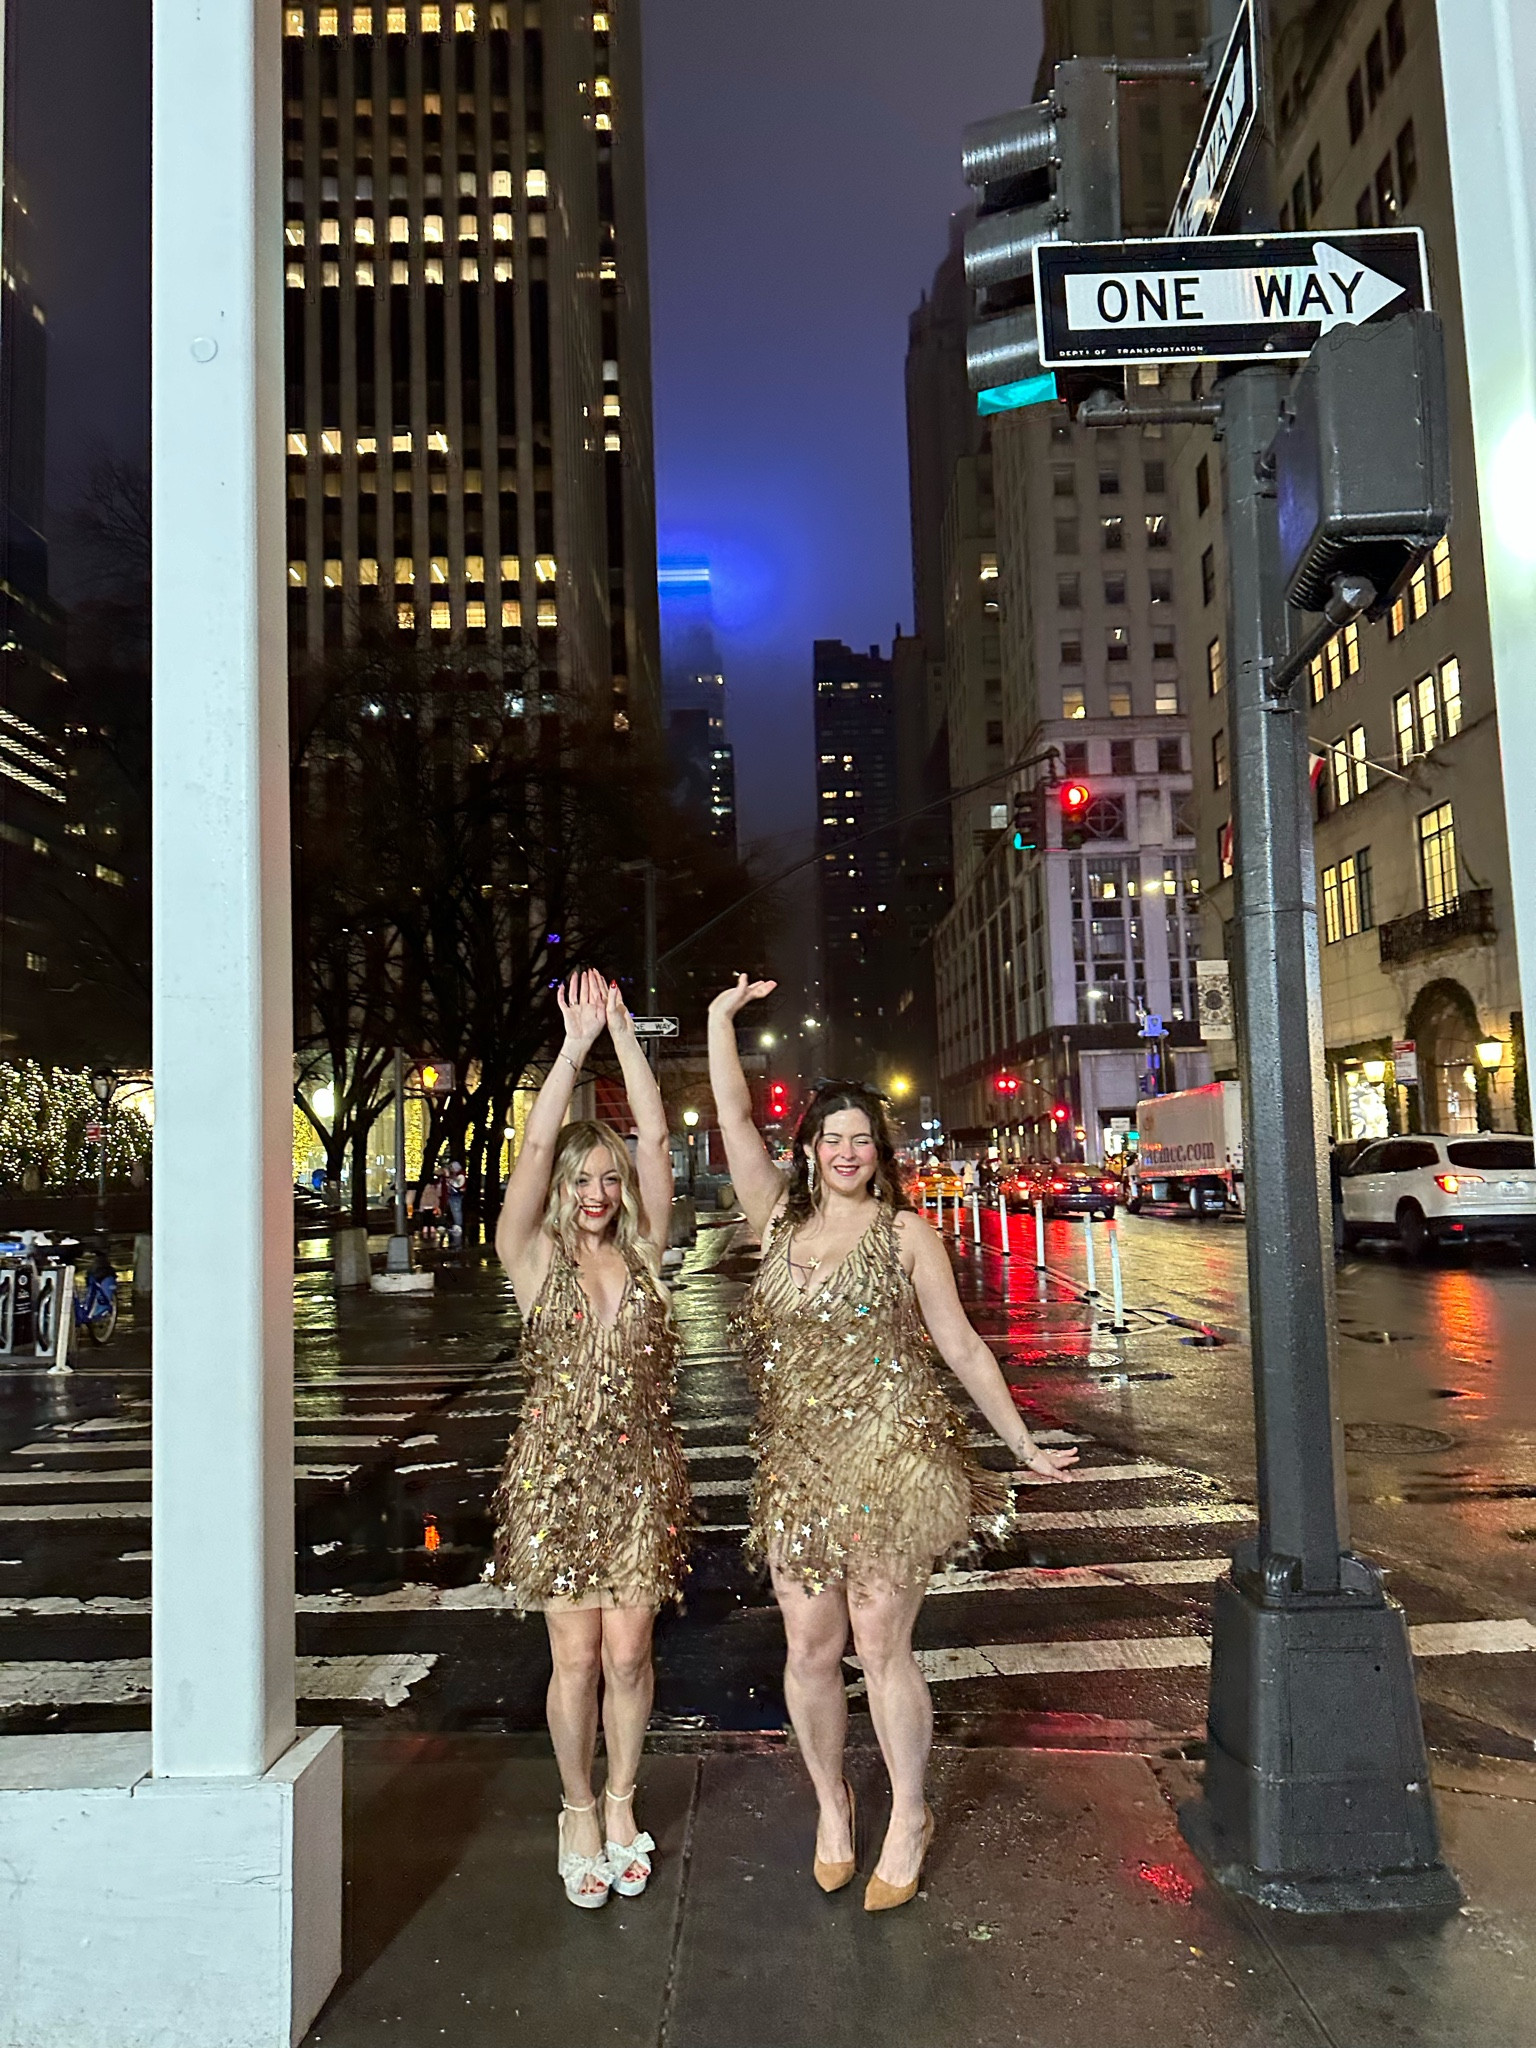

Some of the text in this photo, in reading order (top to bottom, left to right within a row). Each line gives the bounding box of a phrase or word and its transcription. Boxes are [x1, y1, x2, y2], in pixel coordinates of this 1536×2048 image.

[1205, 72, 1236, 190] WAY
[1097, 270, 1364, 323] ONE WAY
[1117, 346, 1204, 354] TRANSPORTATION
[655, 1022, 671, 1030] WAY
